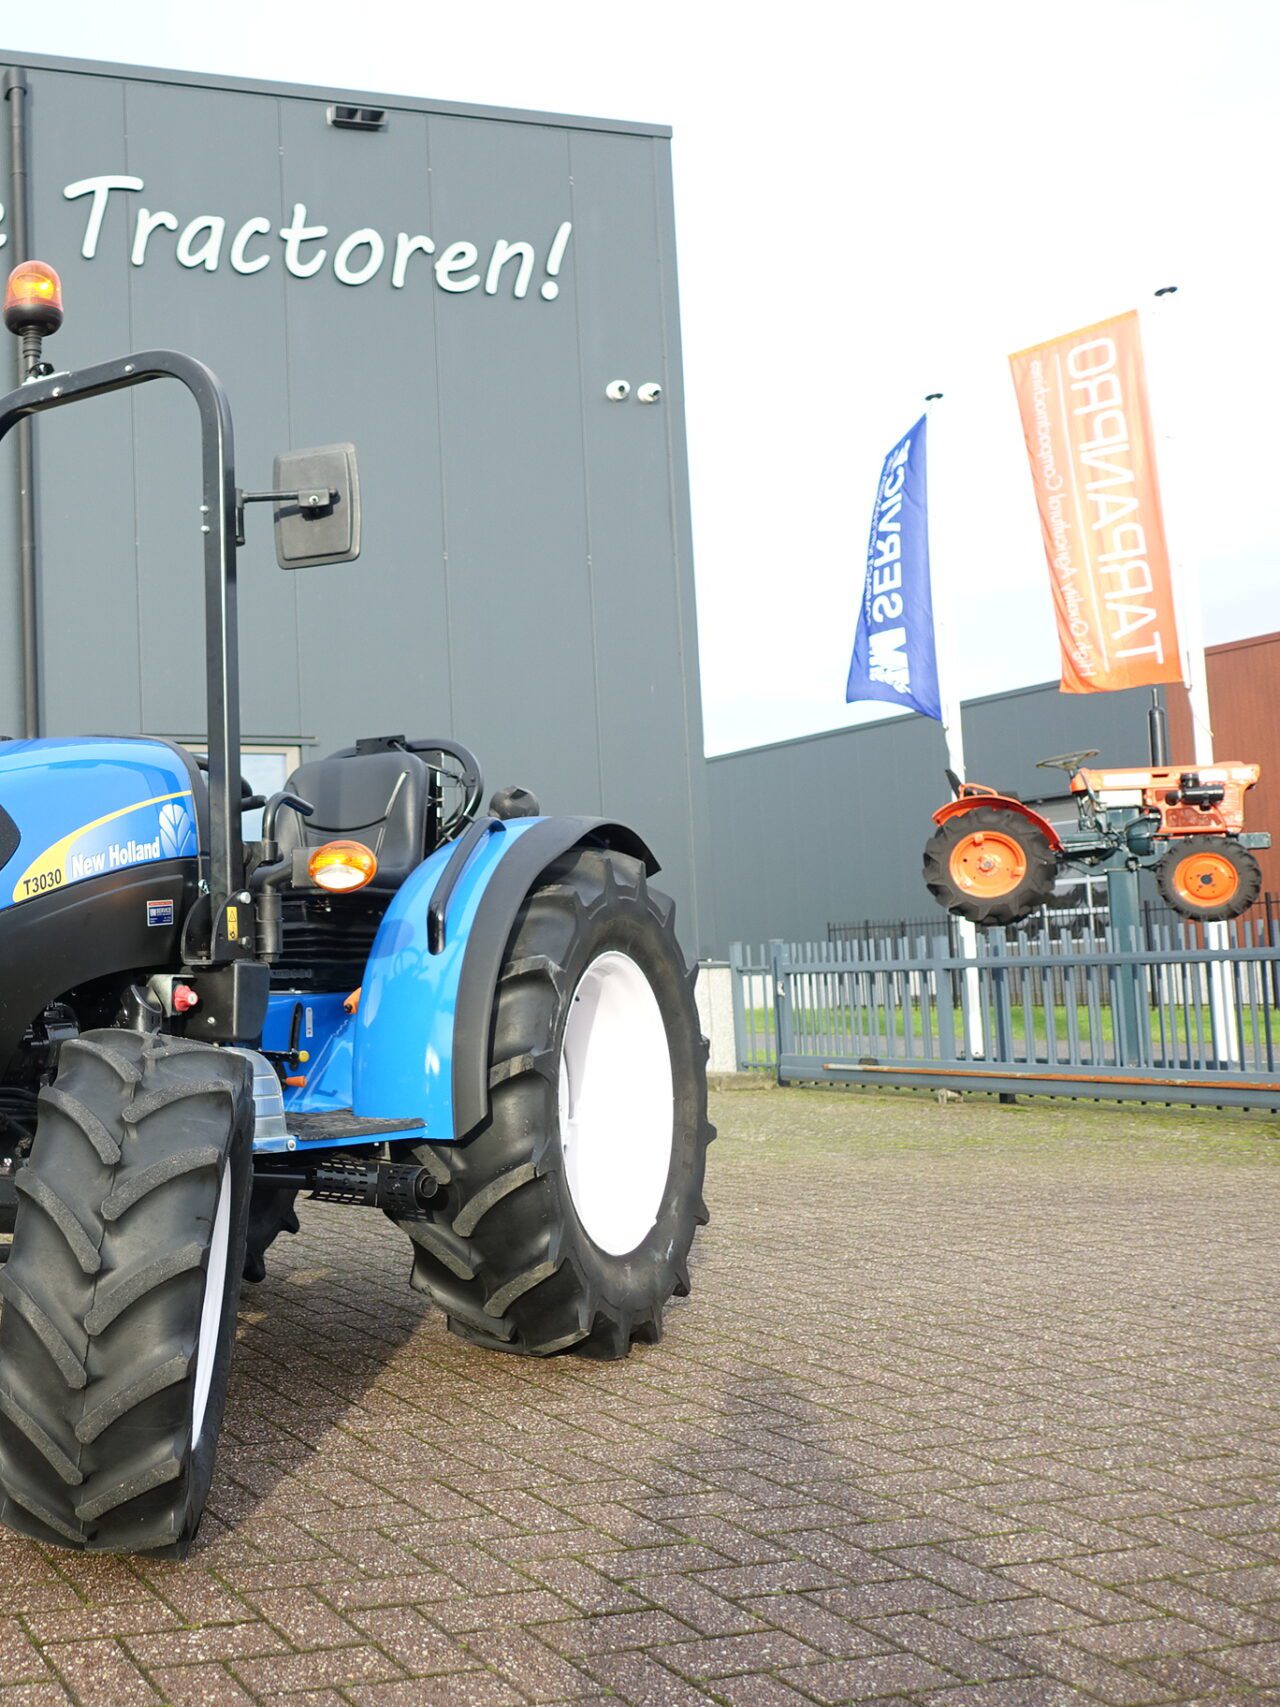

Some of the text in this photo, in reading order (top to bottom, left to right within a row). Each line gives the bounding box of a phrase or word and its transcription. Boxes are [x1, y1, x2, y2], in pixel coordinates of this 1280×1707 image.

[63, 175, 573, 301] Tractoren!
[71, 836, 161, 879] New Holland
[23, 868, 62, 896] T3030
